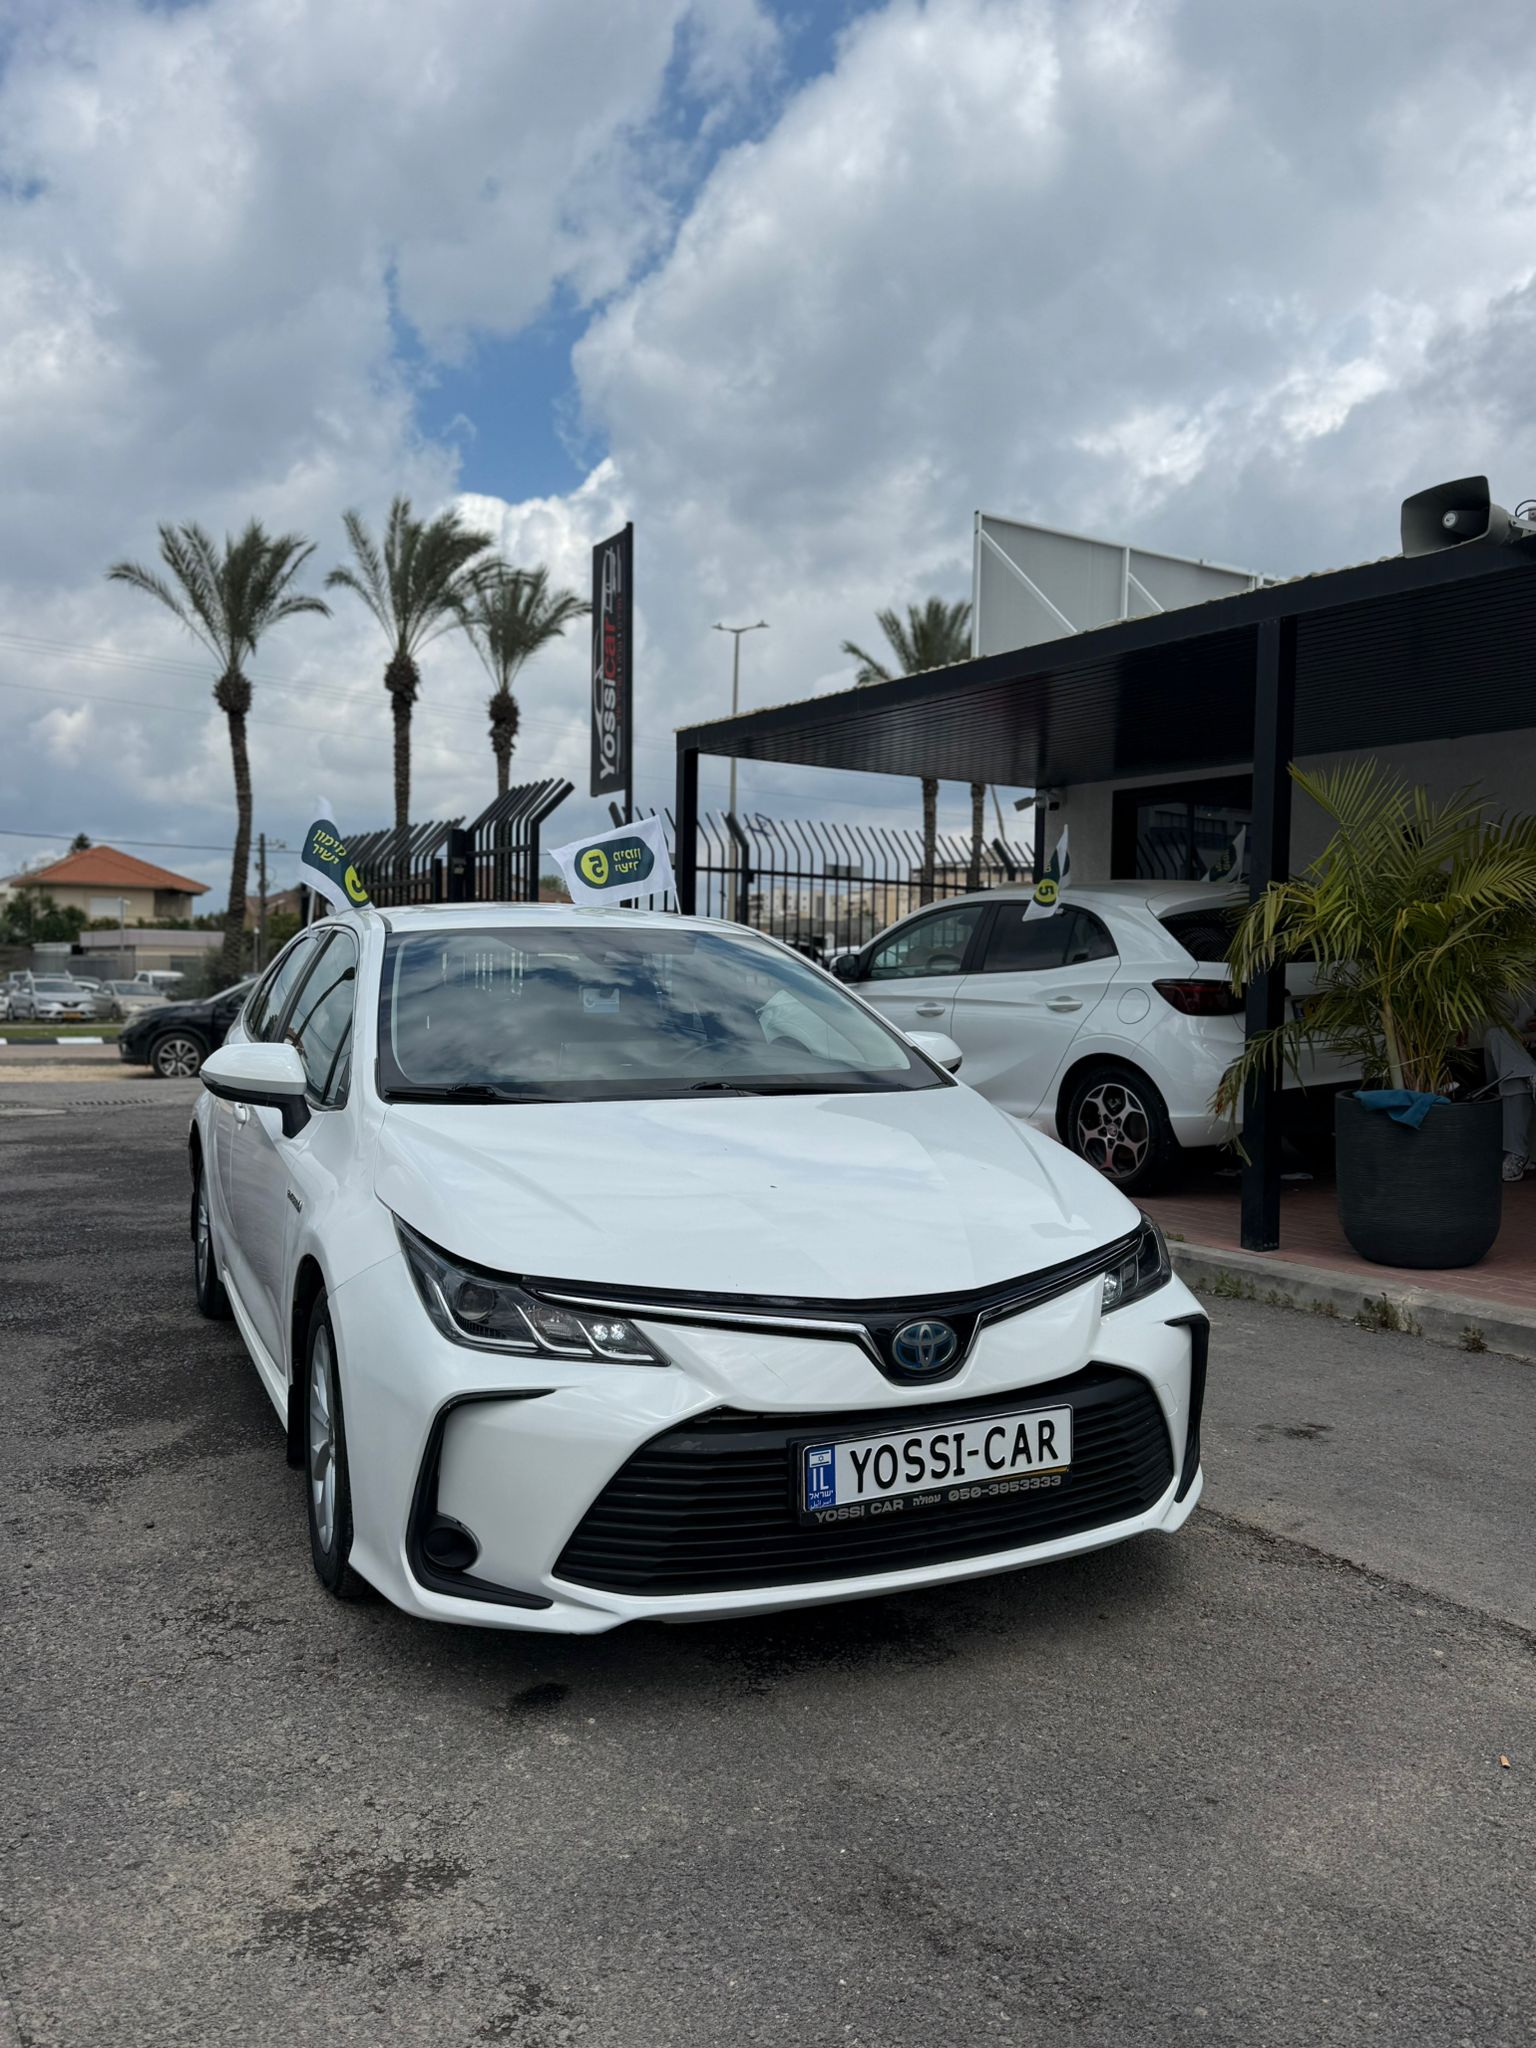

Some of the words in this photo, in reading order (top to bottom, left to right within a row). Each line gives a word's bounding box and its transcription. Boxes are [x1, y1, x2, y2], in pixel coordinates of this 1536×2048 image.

[312, 829, 347, 857] מימון
[312, 843, 340, 865] ישיר
[849, 1419, 1059, 1494] YOSSI-CAR
[813, 1466, 829, 1491] IL
[809, 1489, 834, 1500] ישראל
[815, 1505, 865, 1524] YOSSI
[870, 1499, 905, 1516] CAR
[948, 1475, 1063, 1502] 050-3953333
